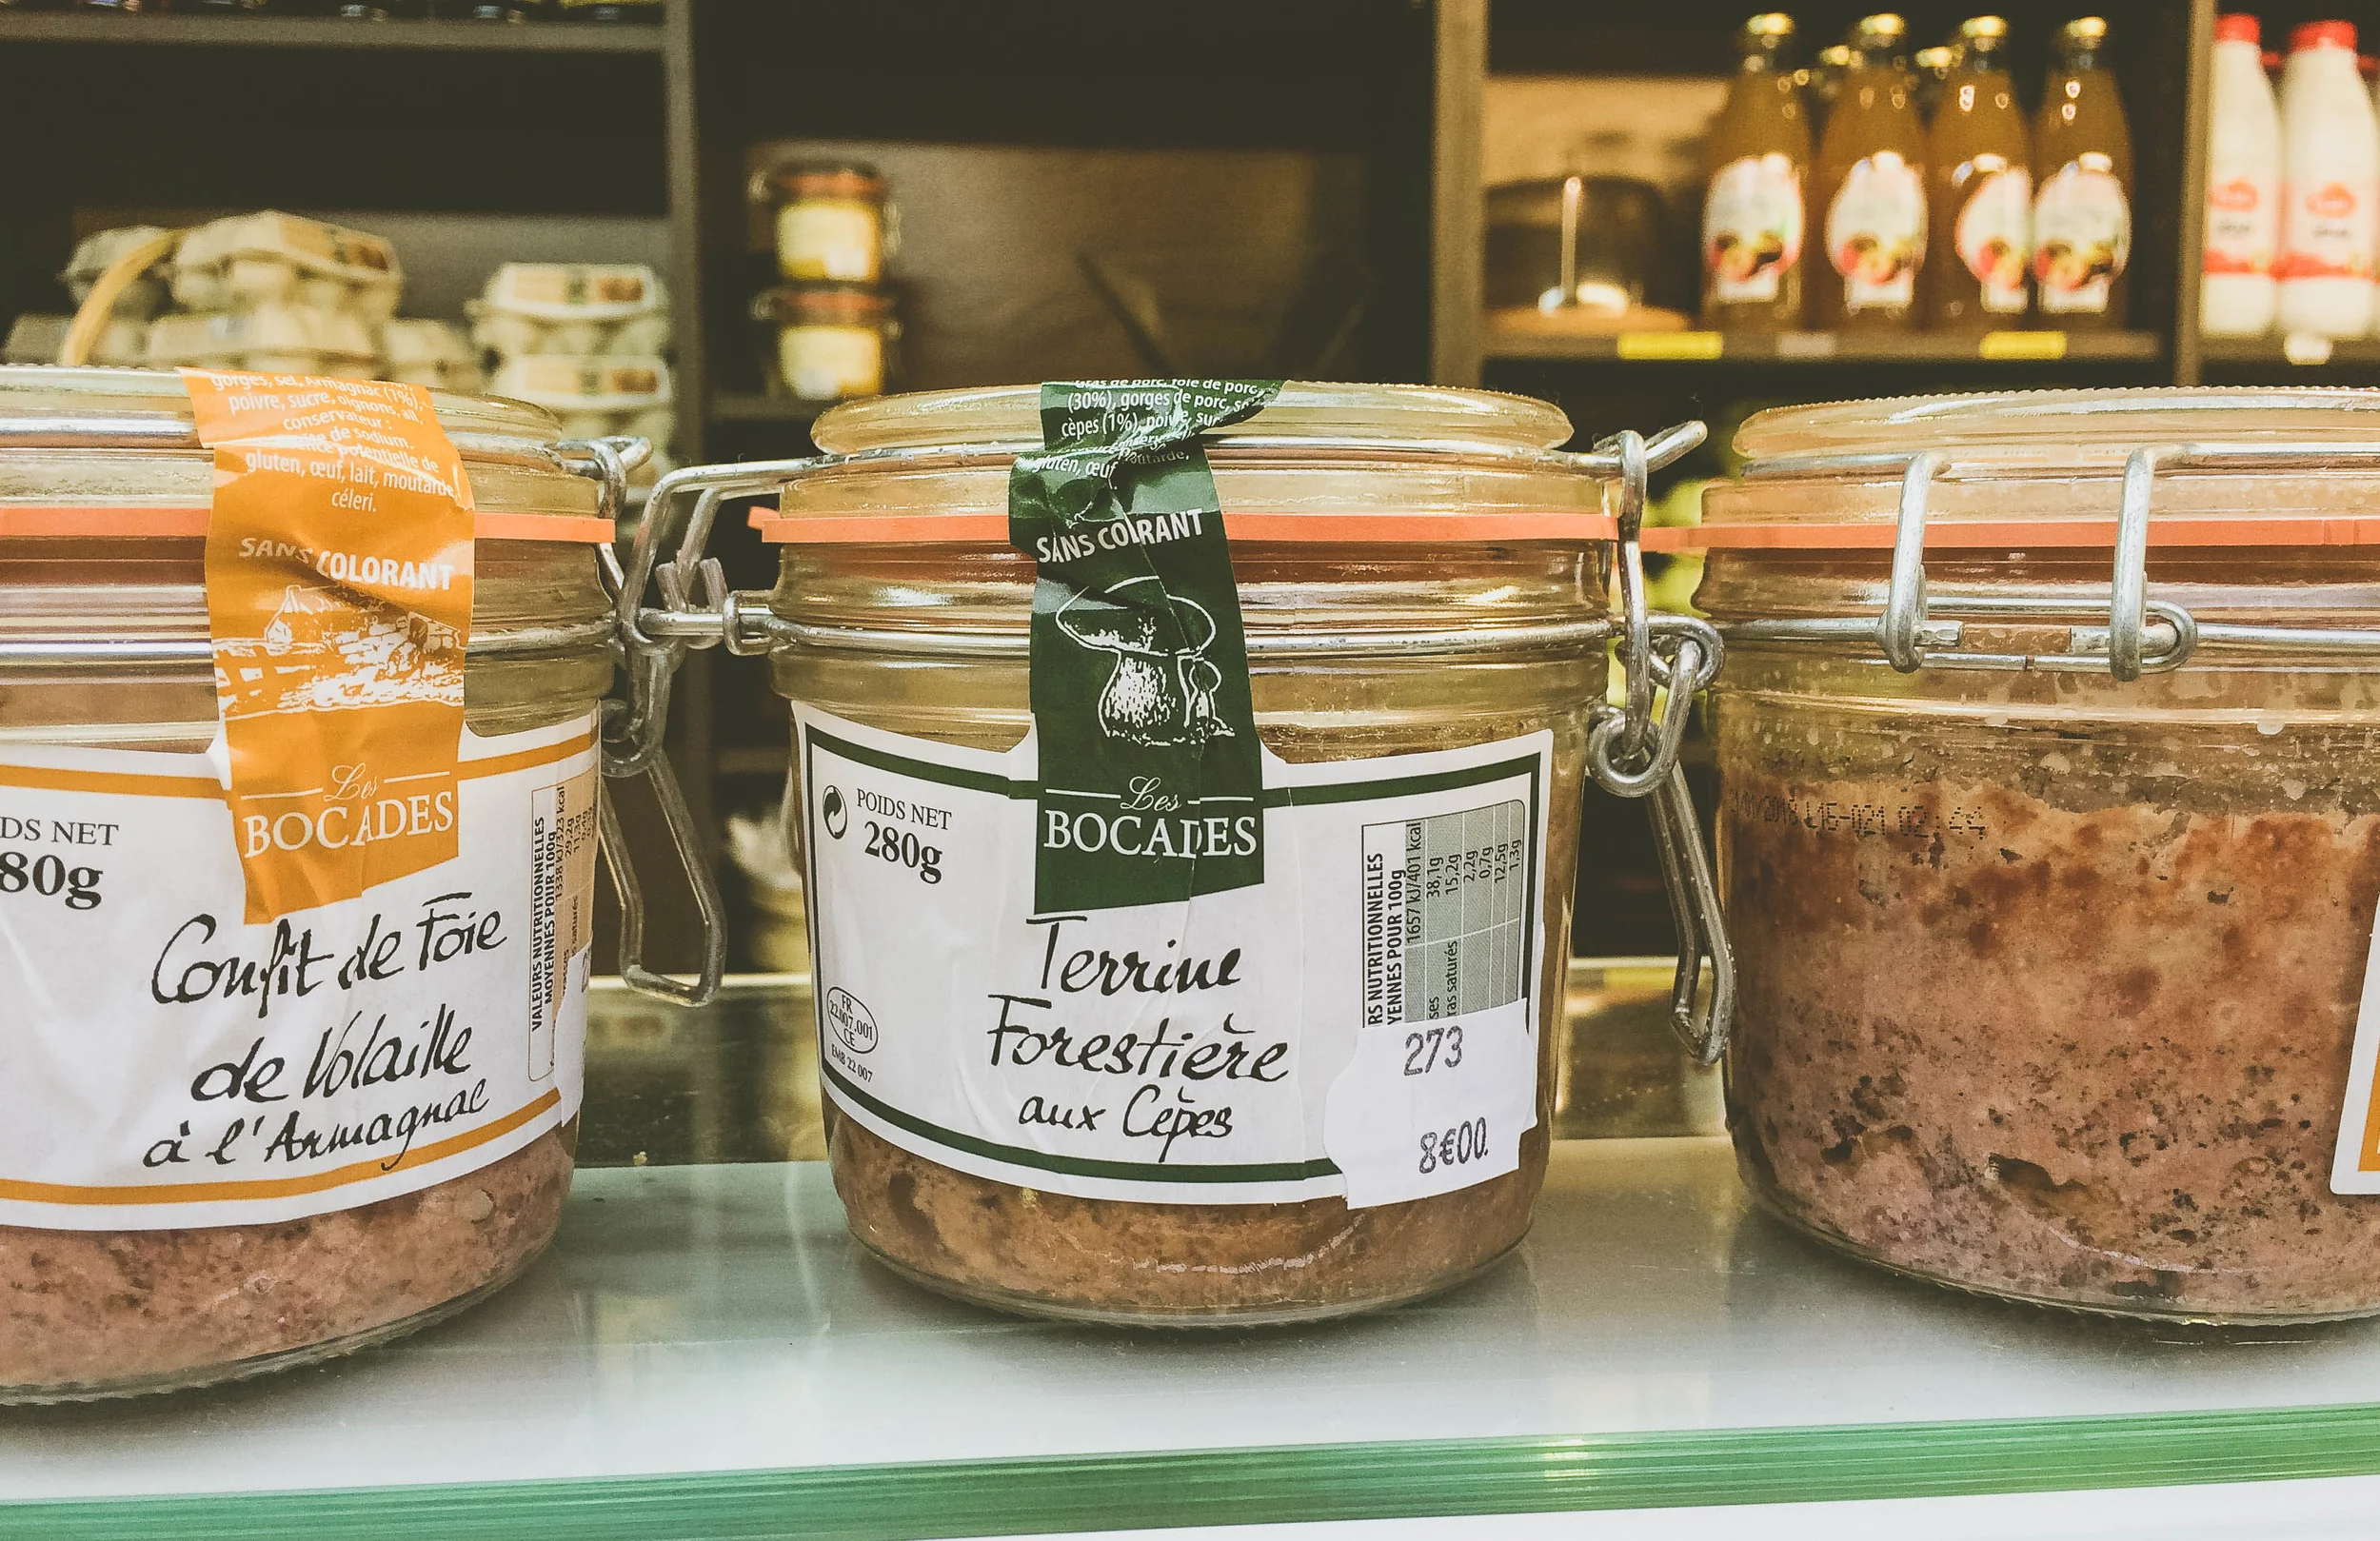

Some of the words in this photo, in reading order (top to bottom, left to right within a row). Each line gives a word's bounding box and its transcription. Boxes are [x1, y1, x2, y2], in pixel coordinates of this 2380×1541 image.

[228, 392, 285, 416] poivre,
[283, 409, 382, 430] conservateur
[1067, 389, 1117, 414] (30%),
[1121, 391, 1170, 411] gorges
[1173, 389, 1192, 405] de
[1194, 396, 1230, 413] porc,
[330, 425, 351, 443] de
[353, 427, 415, 449] sodium.
[1061, 417, 1100, 440] cèpes
[246, 449, 306, 478] gluten,
[349, 461, 380, 488] lait,
[421, 455, 440, 473] de
[331, 487, 377, 513] céleri.
[239, 538, 314, 564] SANS
[315, 549, 454, 591] COLORANT
[323, 762, 379, 802] Les
[556, 785, 565, 815] kcal
[1120, 776, 1182, 812] Les
[242, 791, 454, 859] BOCADES
[857, 788, 906, 820] POIDS
[910, 803, 953, 831] NET
[50, 820, 120, 846] NET
[545, 831, 558, 871] 100g
[864, 820, 943, 885] 280g
[1406, 821, 1421, 852] kcal
[1445, 854, 1462, 896] 15,2g
[1463, 850, 1478, 883] 2,2g
[1478, 846, 1494, 879] 0,7g
[1495, 843, 1509, 884] 12,5g
[1509, 839, 1522, 872] 1,3g
[532, 816, 545, 959] NUTRITIONNELLES
[544, 873, 556, 917] POUR
[1388, 869, 1407, 910] 100g
[1406, 856, 1421, 904] kJ/401
[1426, 857, 1444, 899] 38,1g
[1367, 853, 1383, 1000] NUTRITIONNELLES
[1387, 914, 1402, 960] POUR
[1406, 908, 1421, 944] 1657
[150, 914, 335, 1018] Confit
[339, 914, 406, 991] de
[420, 892, 508, 971] Foie
[544, 919, 556, 1005] MOYENNES
[1026, 915, 1241, 997] Terrine
[1444, 940, 1458, 996] saturés
[531, 963, 544, 1033] VALEURS
[842, 994, 853, 1015] FR
[1387, 962, 1402, 1026] YENNES
[189, 1037, 289, 1105] de
[302, 1002, 473, 1100] Volaille
[843, 1028, 855, 1047] CE
[986, 993, 1290, 1082] Forestière
[1403, 1025, 1464, 1077] 273
[846, 1056, 857, 1074] 22
[857, 1063, 873, 1083] 007
[143, 1120, 190, 1168] à
[1017, 1095, 1107, 1131] aux
[1122, 1084, 1234, 1163] Cèpes
